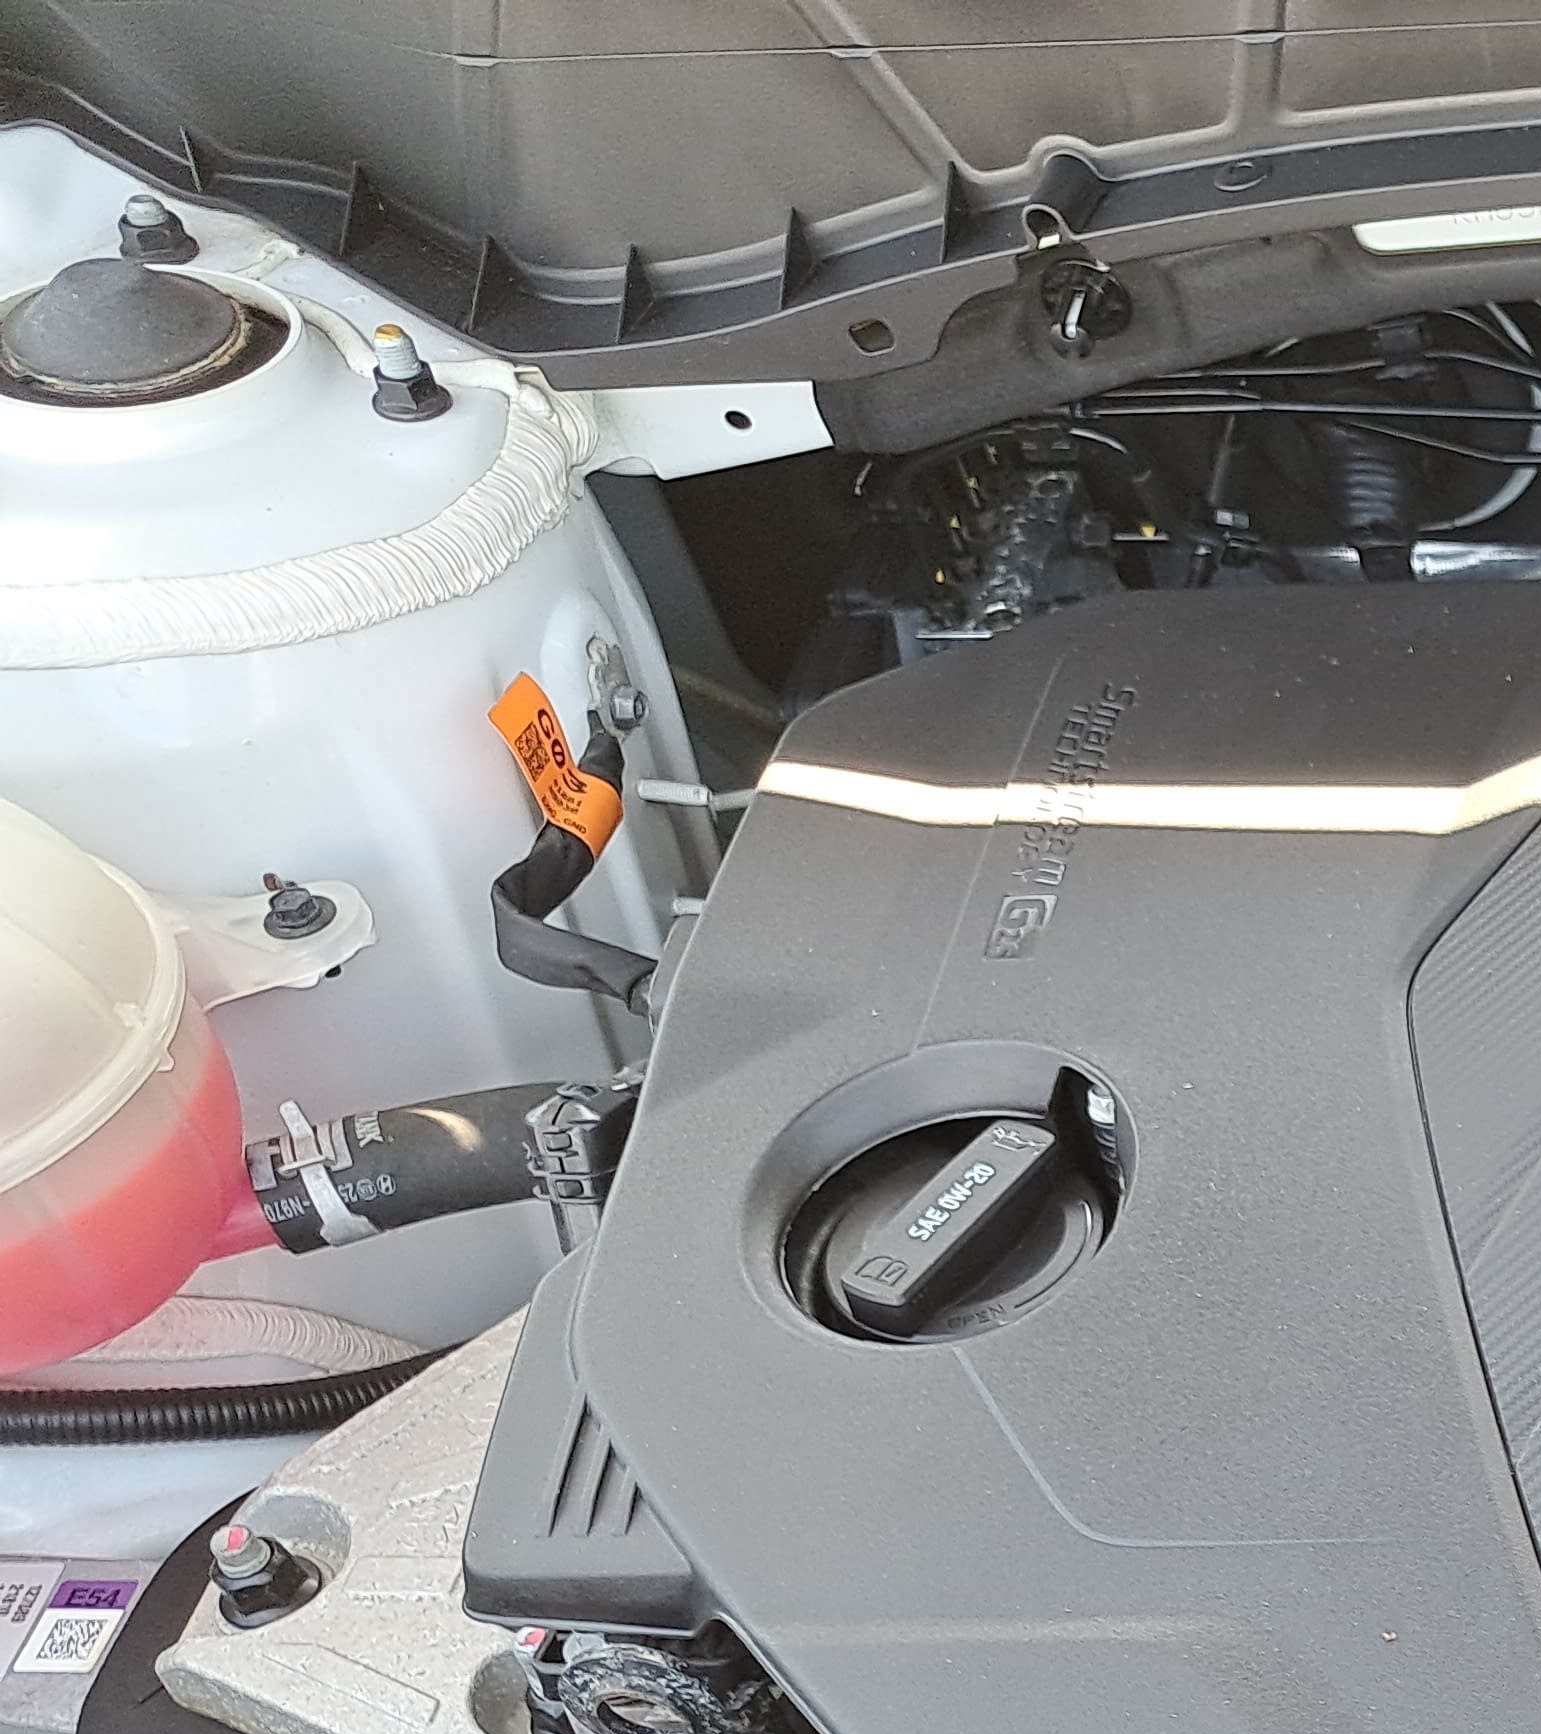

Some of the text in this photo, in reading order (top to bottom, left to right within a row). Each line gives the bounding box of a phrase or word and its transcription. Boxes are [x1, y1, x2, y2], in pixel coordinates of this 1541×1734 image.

[907, 1161, 997, 1242] SAE 0W-20
[946, 1302, 1009, 1329] OPEN
[64, 1587, 121, 1607] E54
